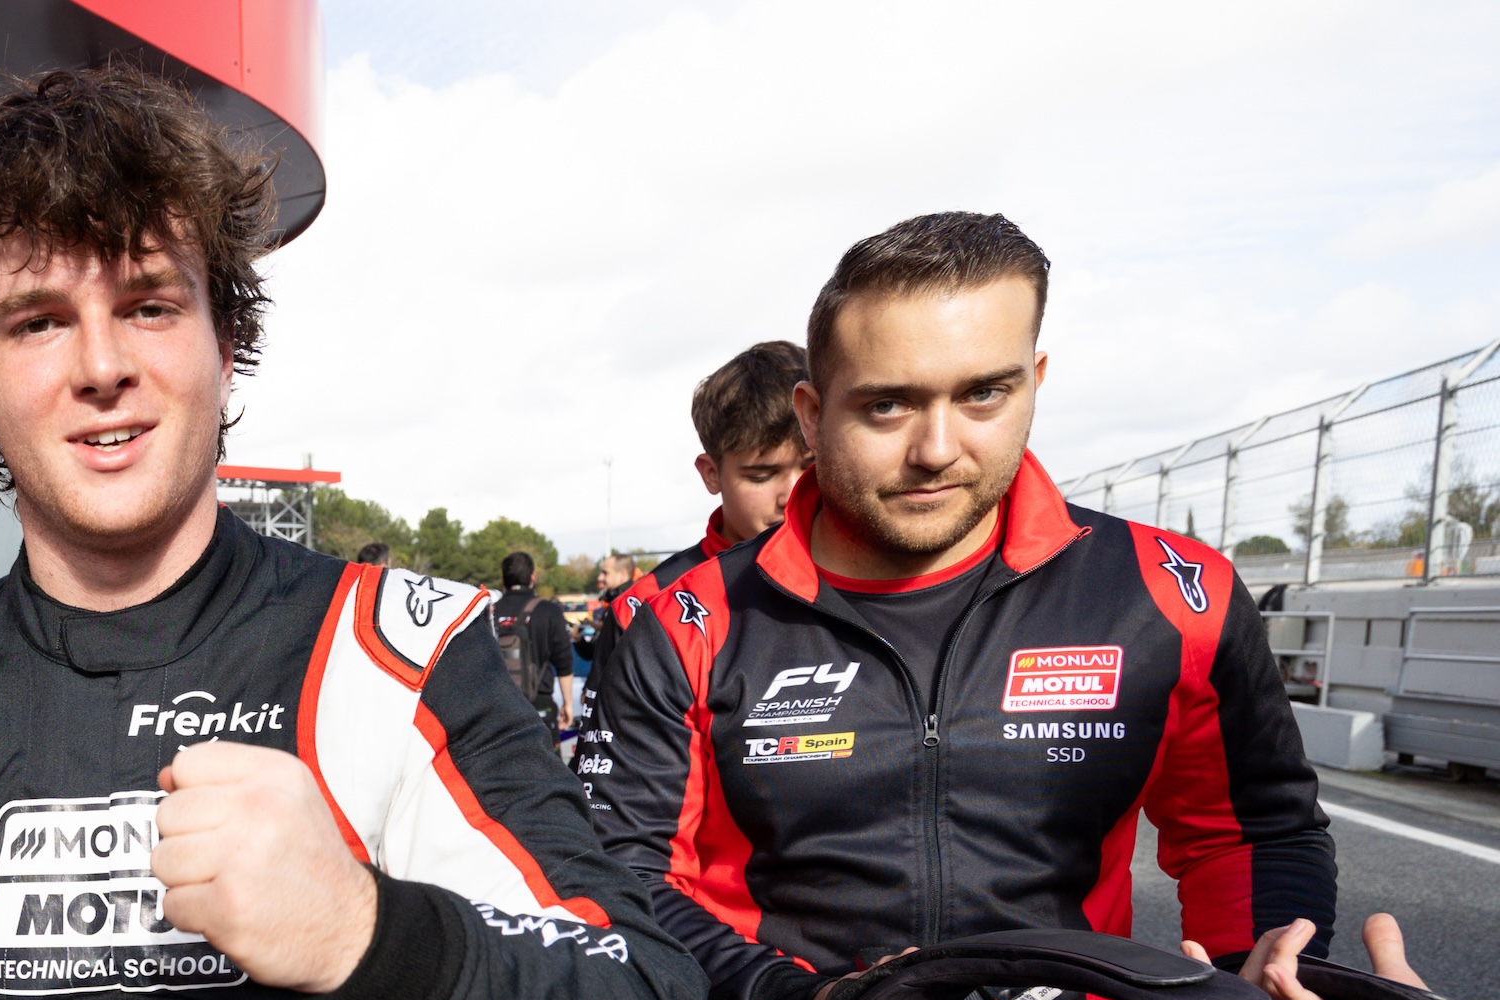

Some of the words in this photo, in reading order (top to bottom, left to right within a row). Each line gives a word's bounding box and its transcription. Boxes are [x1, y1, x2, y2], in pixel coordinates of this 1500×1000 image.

[1037, 654, 1114, 667] MONLAU
[762, 661, 861, 700] F4
[1020, 676, 1104, 693] MOTUL
[752, 696, 843, 712] SPANISH
[1010, 698, 1067, 708] TECHNICAL
[1069, 698, 1111, 706] SCHOOL
[128, 702, 285, 736] Frenkit
[748, 706, 837, 718] CHAMPIONSHIP
[1003, 722, 1126, 739] SAMSUNG
[745, 736, 800, 757] TCR
[805, 737, 848, 749] Spain
[1046, 747, 1086, 762] SSD
[577, 754, 613, 775] Beta
[783, 753, 830, 761] CHAMPIONSHIP
[590, 803, 612, 811] ACING
[54, 820, 153, 858] MON
[15, 889, 175, 936] MOTU
[123, 954, 232, 978] SCHOOL
